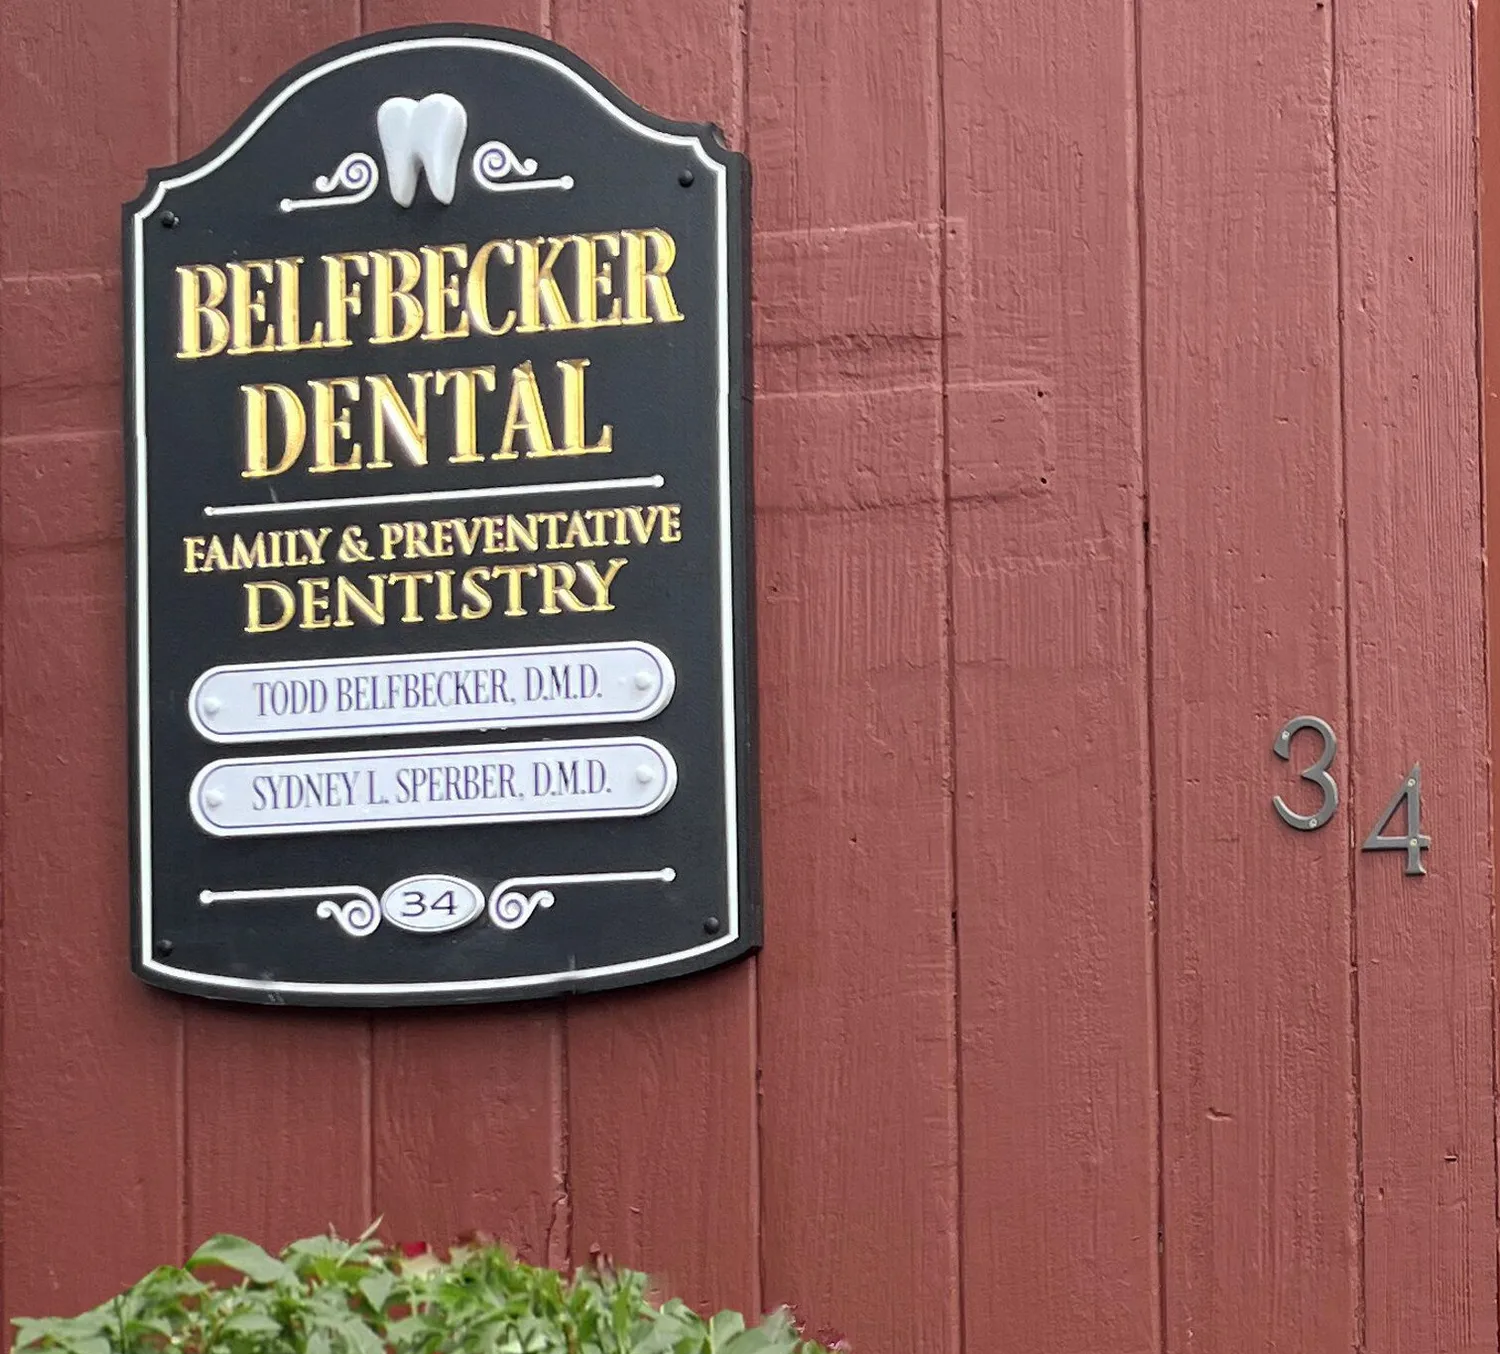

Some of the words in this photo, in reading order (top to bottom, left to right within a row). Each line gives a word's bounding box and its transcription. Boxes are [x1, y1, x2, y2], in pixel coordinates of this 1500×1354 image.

[175, 228, 684, 360] BELFBECKER
[240, 358, 613, 479] DENTAL
[183, 525, 332, 574] FAMILY
[337, 525, 374, 563] &
[379, 503, 683, 562] PREVENTATIVE
[243, 557, 629, 634] DENTISTRY
[252, 680, 328, 718] TODD
[335, 668, 517, 713] BELFBECKER,
[525, 662, 604, 703] D.M.D.
[251, 772, 362, 812] SYDNEY
[367, 769, 391, 806] L.
[532, 757, 613, 797] D.M.D.
[400, 889, 460, 919] 34
